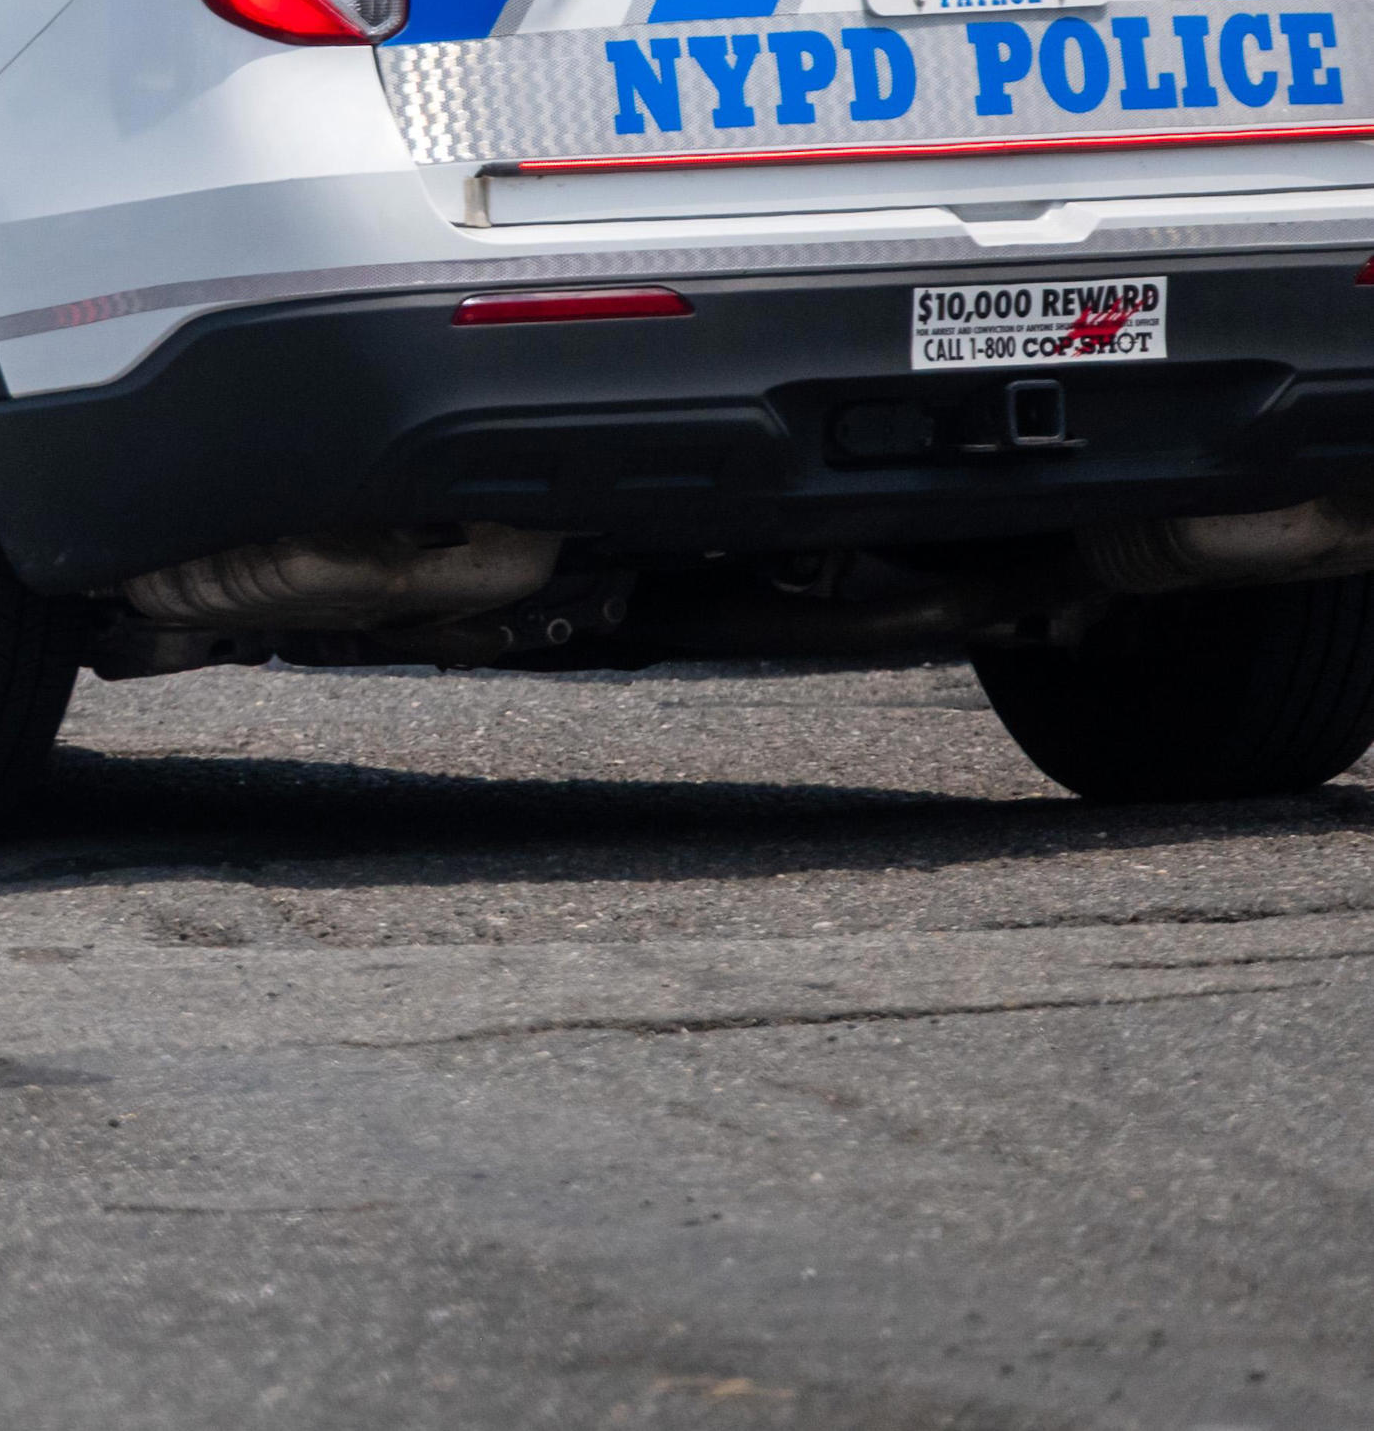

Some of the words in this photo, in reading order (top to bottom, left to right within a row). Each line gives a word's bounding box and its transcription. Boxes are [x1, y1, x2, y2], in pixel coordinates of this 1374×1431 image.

[605, 26, 917, 136] NYPD
[966, 12, 1344, 118] POLICE
[918, 289, 1032, 325] $10,000
[1041, 283, 1160, 318] REWARD
[924, 337, 964, 362] CALL
[969, 335, 1017, 362] 1-800
